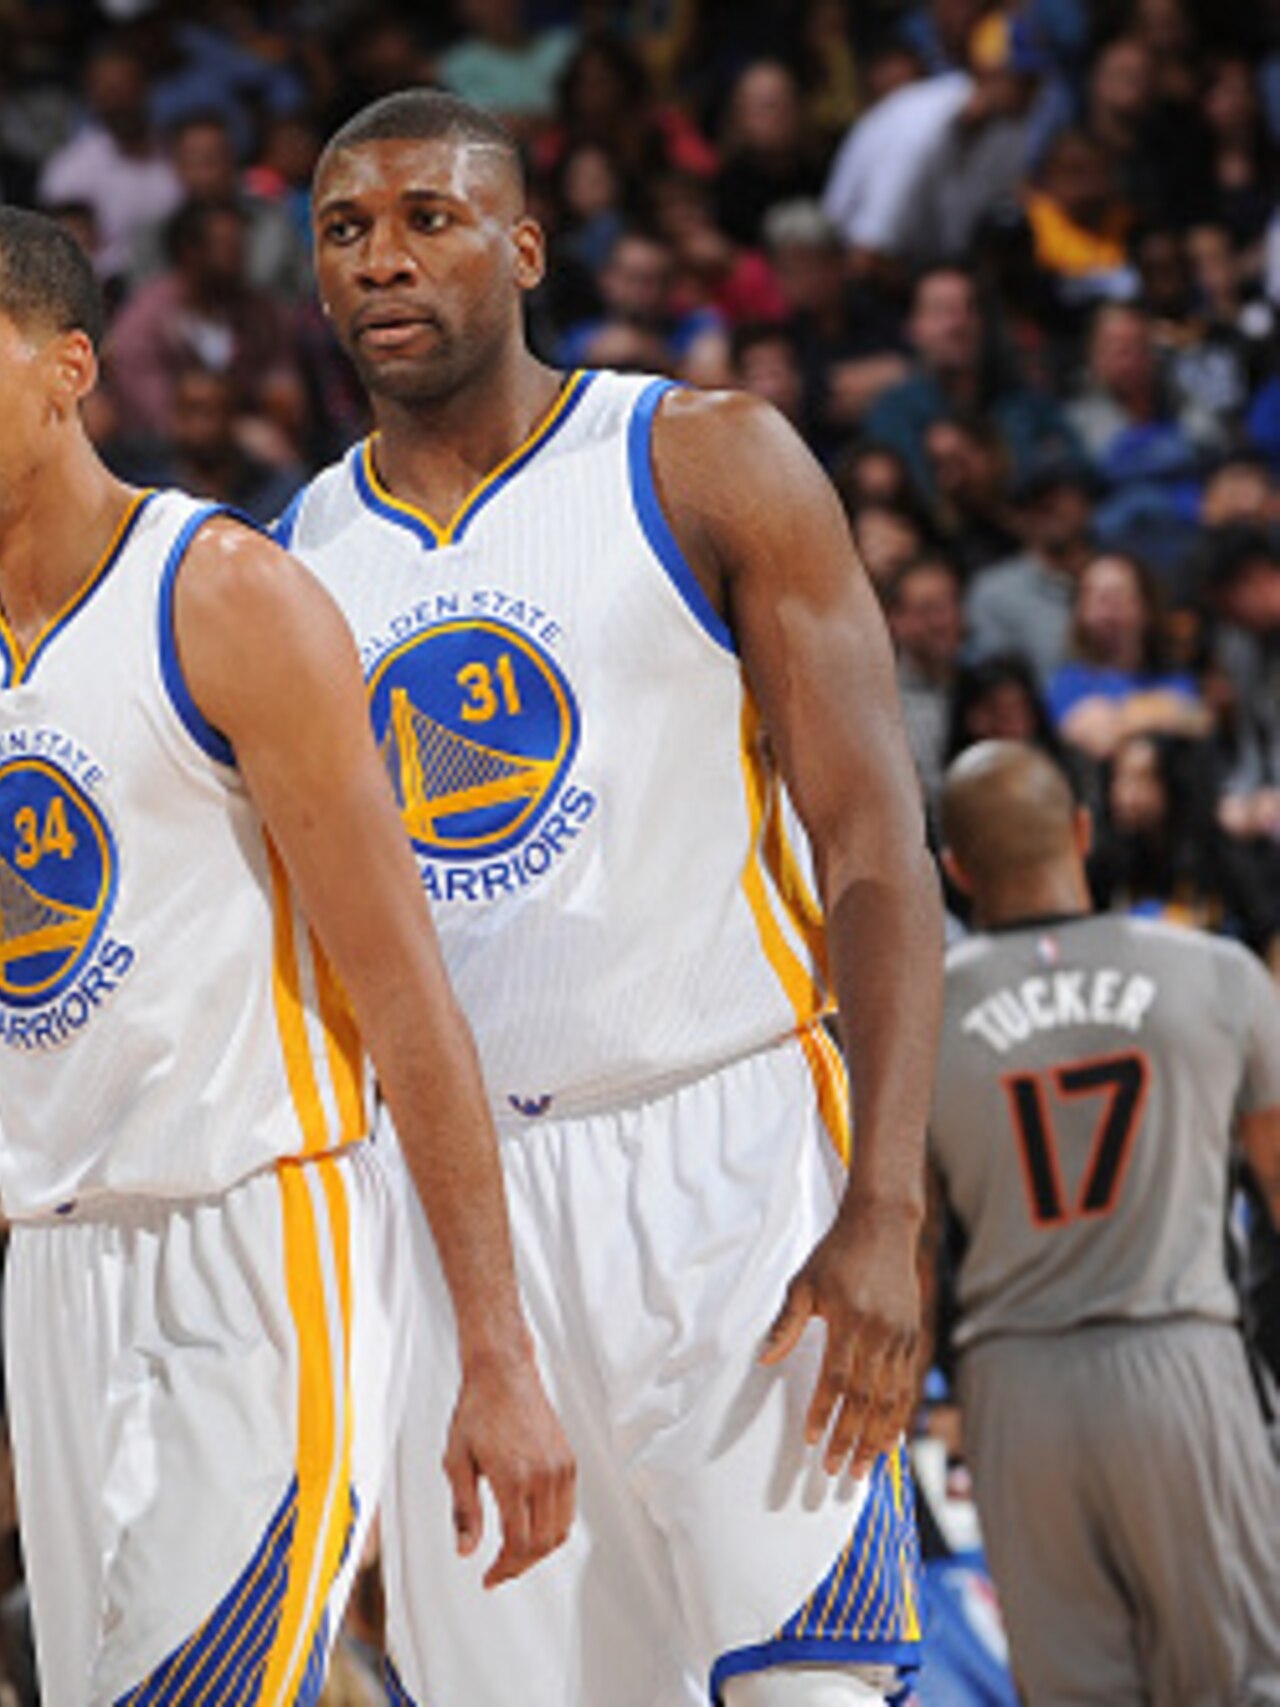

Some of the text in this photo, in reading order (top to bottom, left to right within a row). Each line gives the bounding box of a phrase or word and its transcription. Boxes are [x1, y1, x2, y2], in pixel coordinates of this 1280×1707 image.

[472, 591, 561, 648] STATE
[456, 653, 520, 723] 31
[33, 730, 104, 791] STATE
[14, 796, 77, 869] 34
[962, 969, 1157, 1052] TUCKER
[1000, 1046, 1152, 1229] 17
